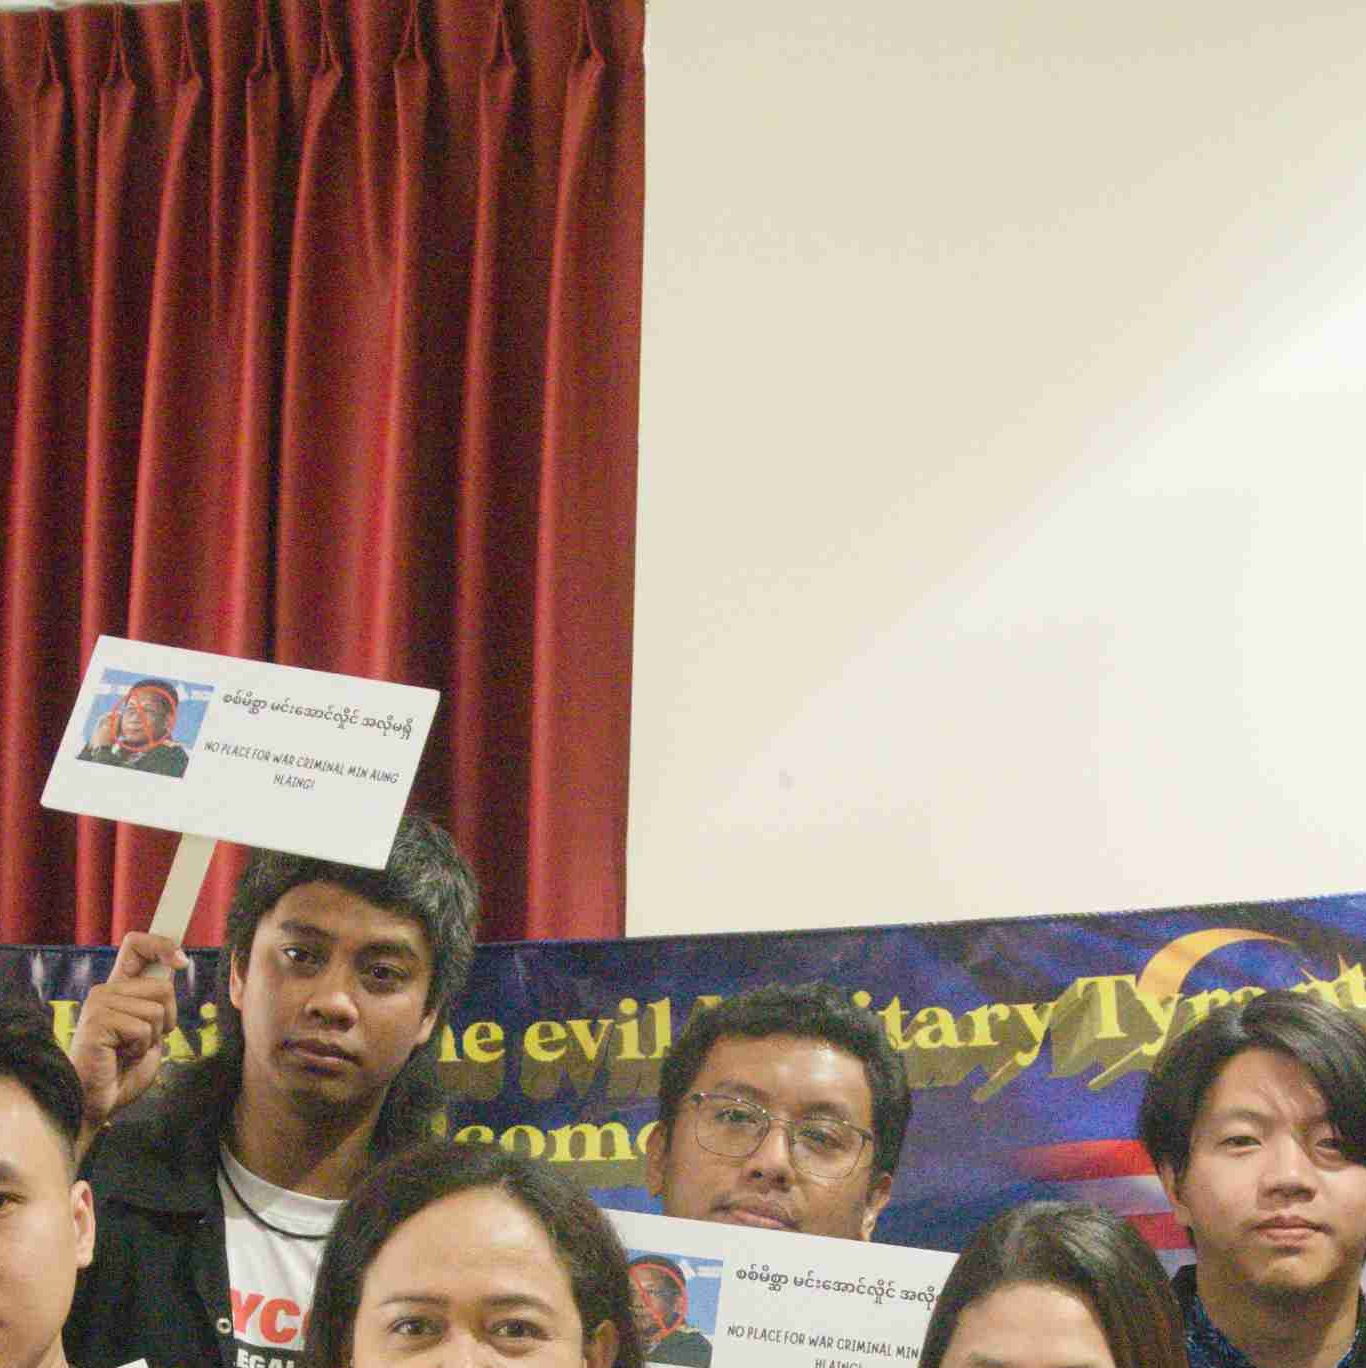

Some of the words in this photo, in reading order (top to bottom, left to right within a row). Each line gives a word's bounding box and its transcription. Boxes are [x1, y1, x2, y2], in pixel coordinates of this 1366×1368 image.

[205, 741, 220, 753] NO
[221, 743, 252, 759] PLACE
[251, 748, 271, 762] FOR
[272, 753, 296, 766] WAR
[295, 756, 345, 776] CRIMINAL
[347, 766, 368, 778] MIN
[369, 768, 400, 784] AUNG
[523, 997, 672, 1062] evil
[727, 1325, 745, 1338] NO
[746, 1326, 782, 1344] PLACE
[783, 1330, 806, 1345] FOR
[808, 1335, 834, 1349] WAR
[836, 1338, 892, 1357] CRIMINAL
[895, 1345, 919, 1360] MIN
